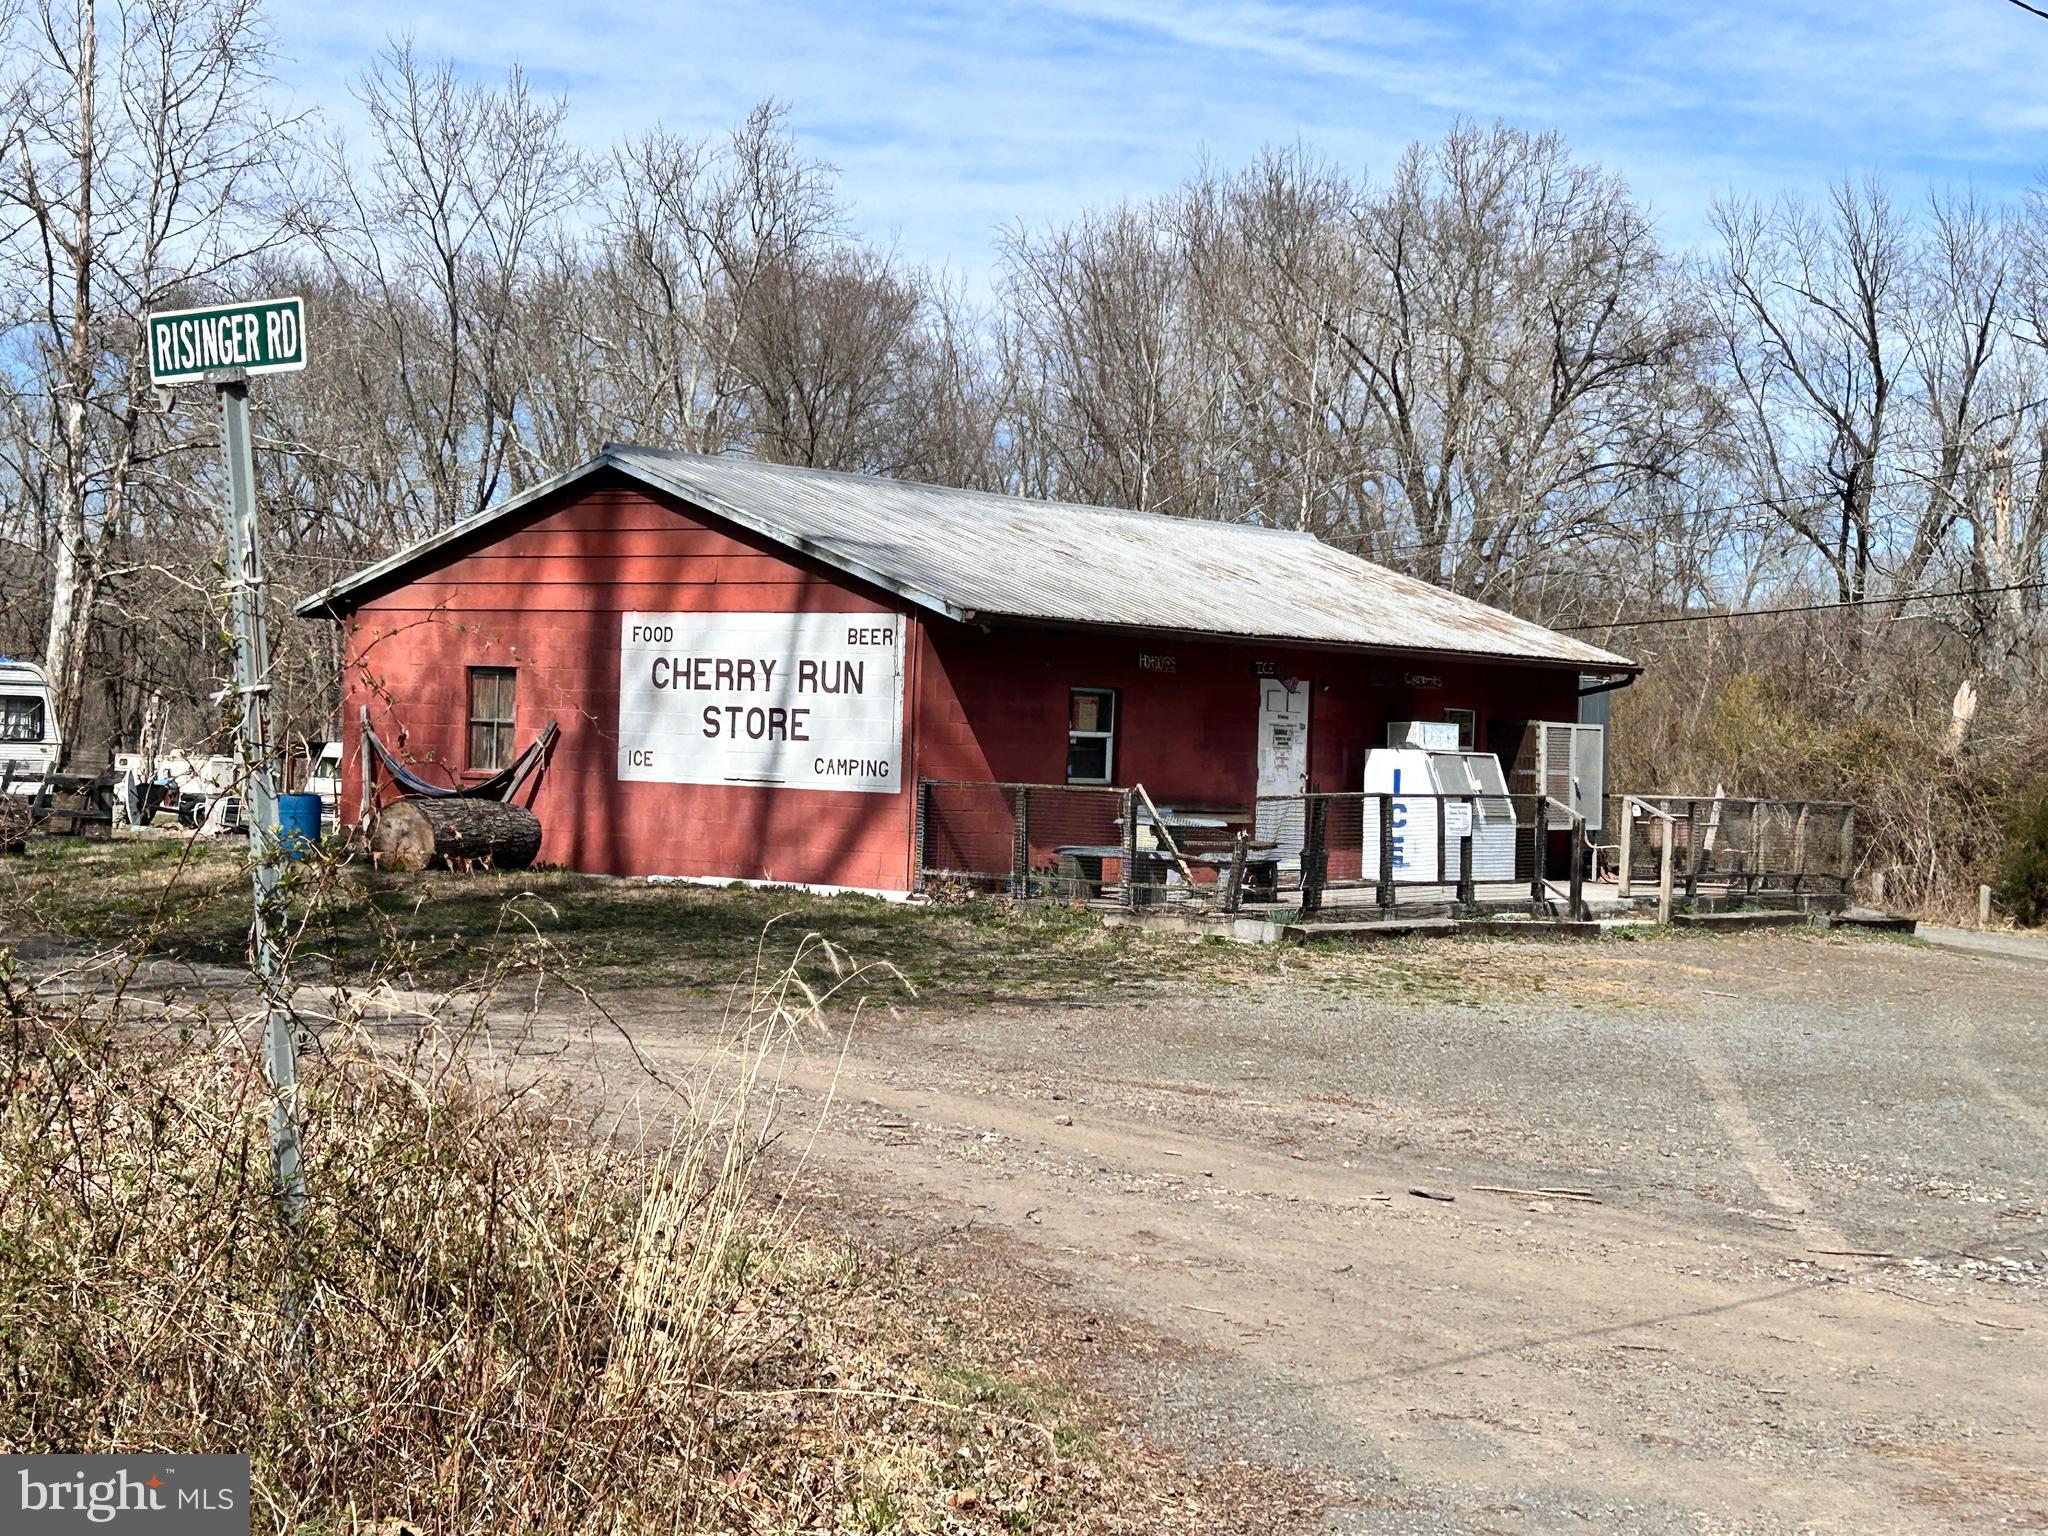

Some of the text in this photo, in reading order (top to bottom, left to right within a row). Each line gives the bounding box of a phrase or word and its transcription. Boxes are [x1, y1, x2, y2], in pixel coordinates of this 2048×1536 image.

[156, 308, 297, 371] RISINGER RD
[632, 626, 673, 643] FOOD
[847, 627, 894, 646] BEER
[651, 656, 864, 694] CHERRY RUN
[702, 705, 811, 742] STORE
[628, 749, 654, 767] ICE
[814, 757, 889, 778] CAMPING
